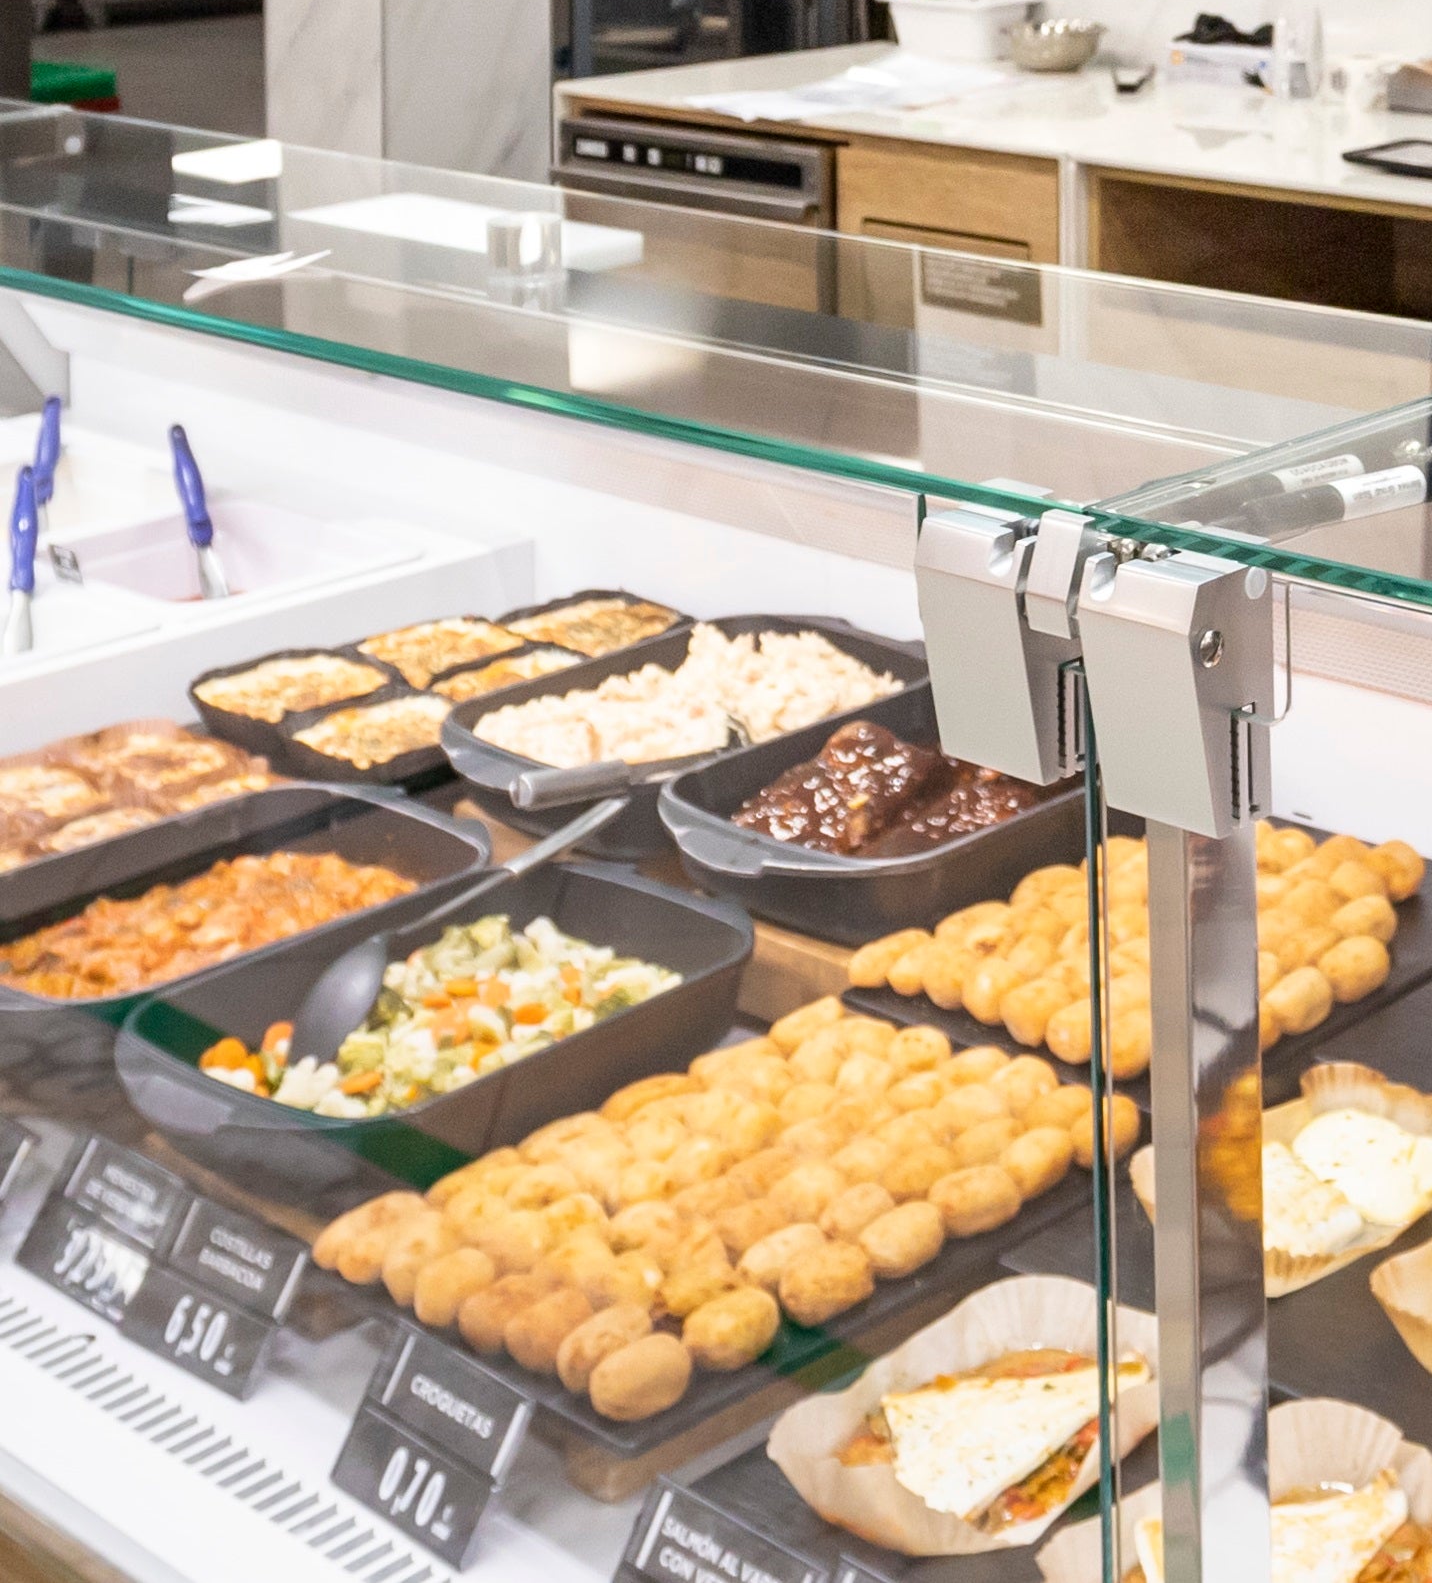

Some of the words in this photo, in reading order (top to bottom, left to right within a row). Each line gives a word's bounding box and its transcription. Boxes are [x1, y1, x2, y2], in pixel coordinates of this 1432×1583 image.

[410, 1372, 495, 1440] CROQUETAS
[378, 1445, 447, 1528] 0,70
[661, 1515, 724, 1565] SALMÓN
